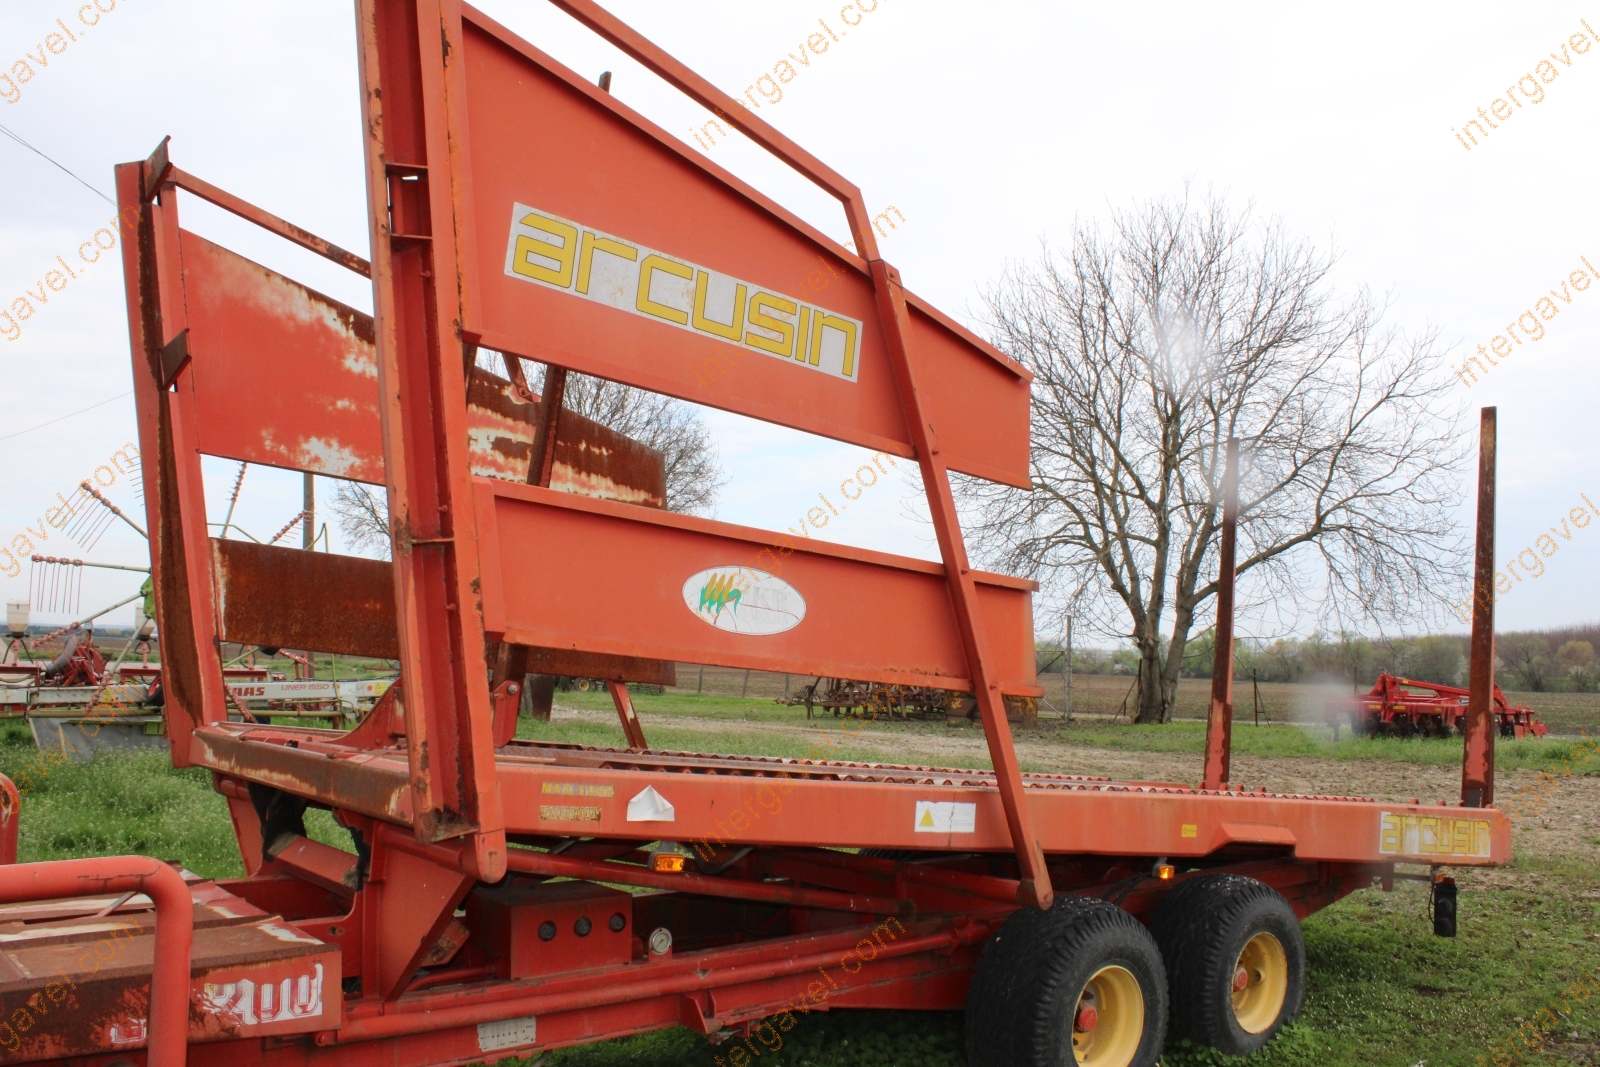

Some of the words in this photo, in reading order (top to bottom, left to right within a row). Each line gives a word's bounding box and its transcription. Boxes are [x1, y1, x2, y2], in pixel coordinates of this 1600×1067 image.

[512, 212, 857, 378] arcusin
[542, 782, 571, 794] MAX
[579, 784, 615, 798] LOAD
[1381, 814, 1491, 856] arcusin
